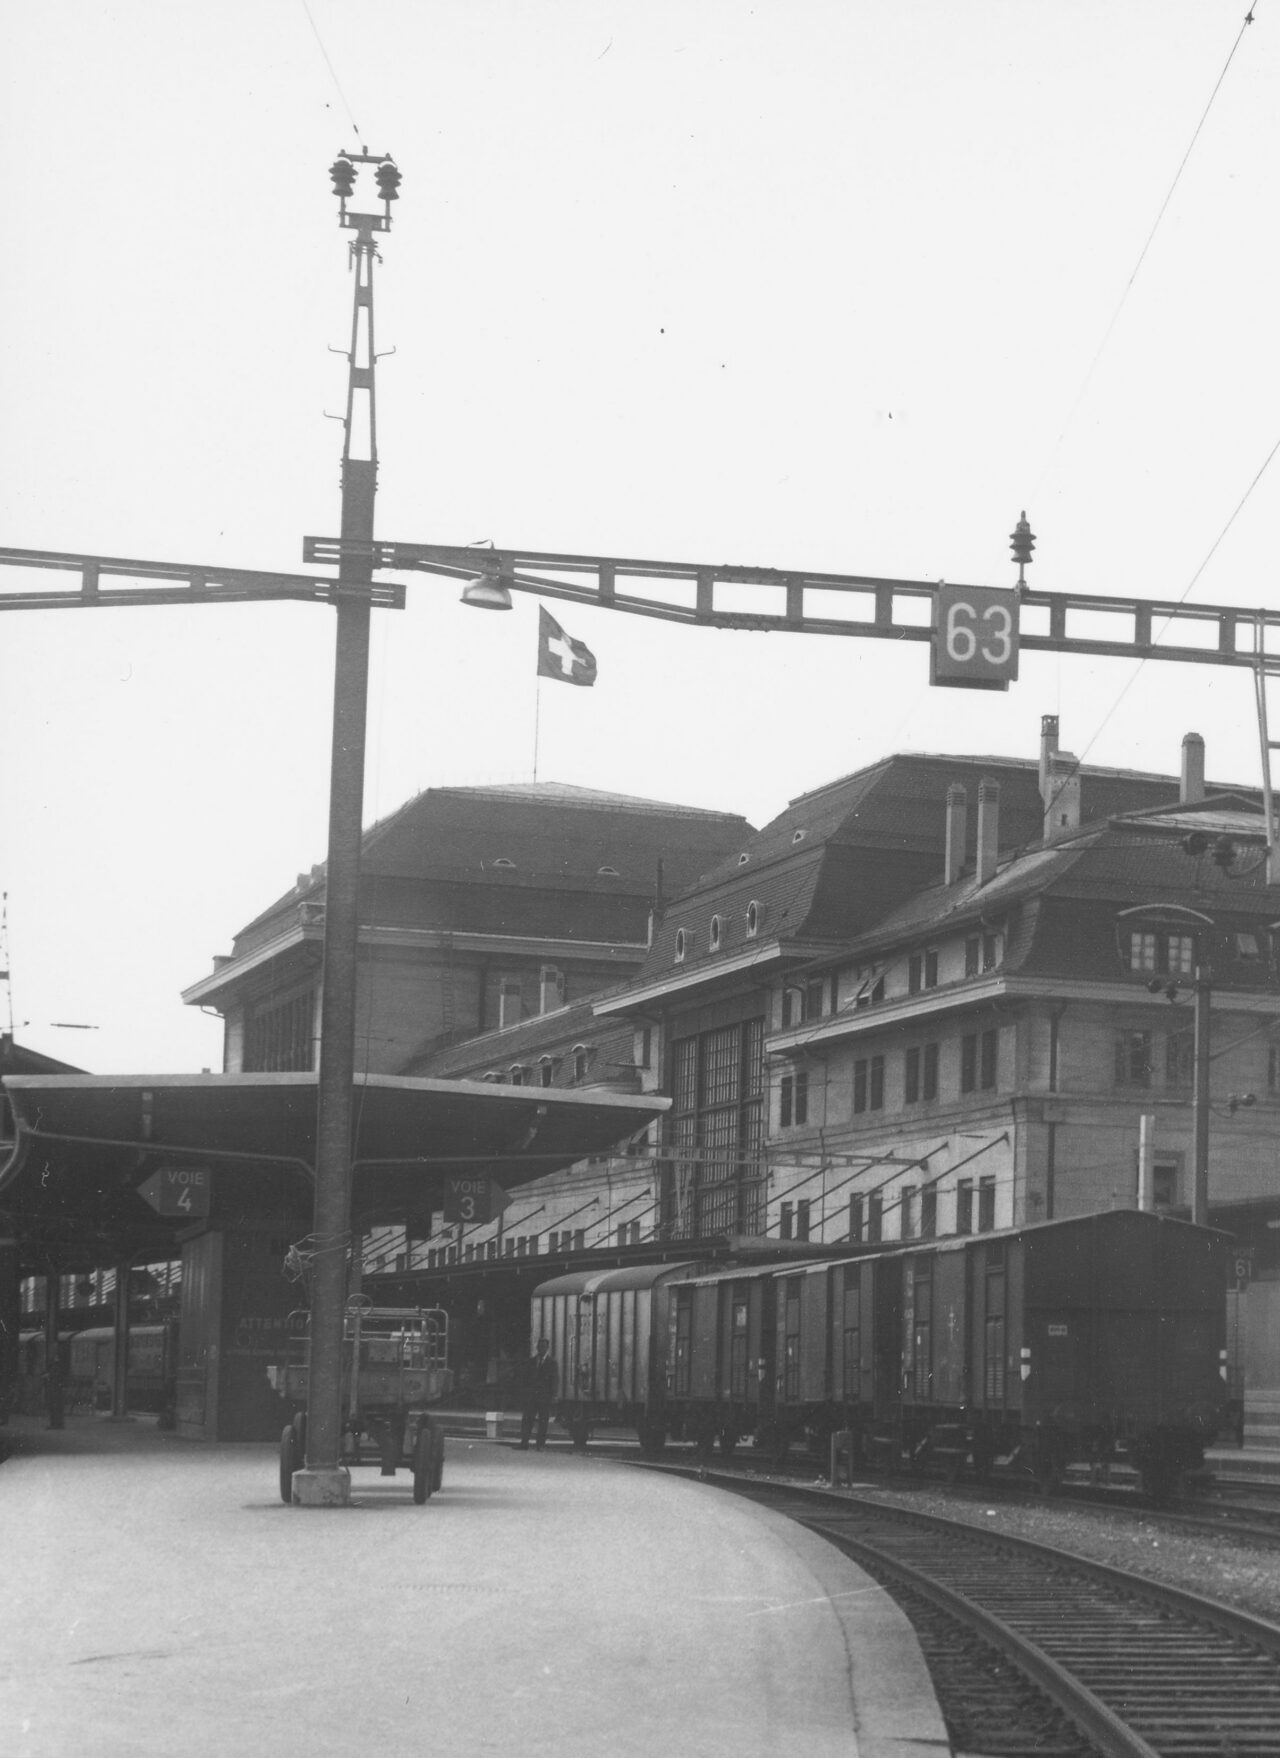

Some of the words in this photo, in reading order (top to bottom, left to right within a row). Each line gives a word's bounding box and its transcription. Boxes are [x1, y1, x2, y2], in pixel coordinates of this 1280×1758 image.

[946, 602, 1012, 665] 63
[167, 1171, 205, 1185] VOIE
[451, 1180, 486, 1194] VOIE
[176, 1186, 193, 1213] 4
[460, 1196, 475, 1220] 3
[1235, 1258, 1252, 1278] 61
[239, 1317, 307, 1330] ATTENTIO
